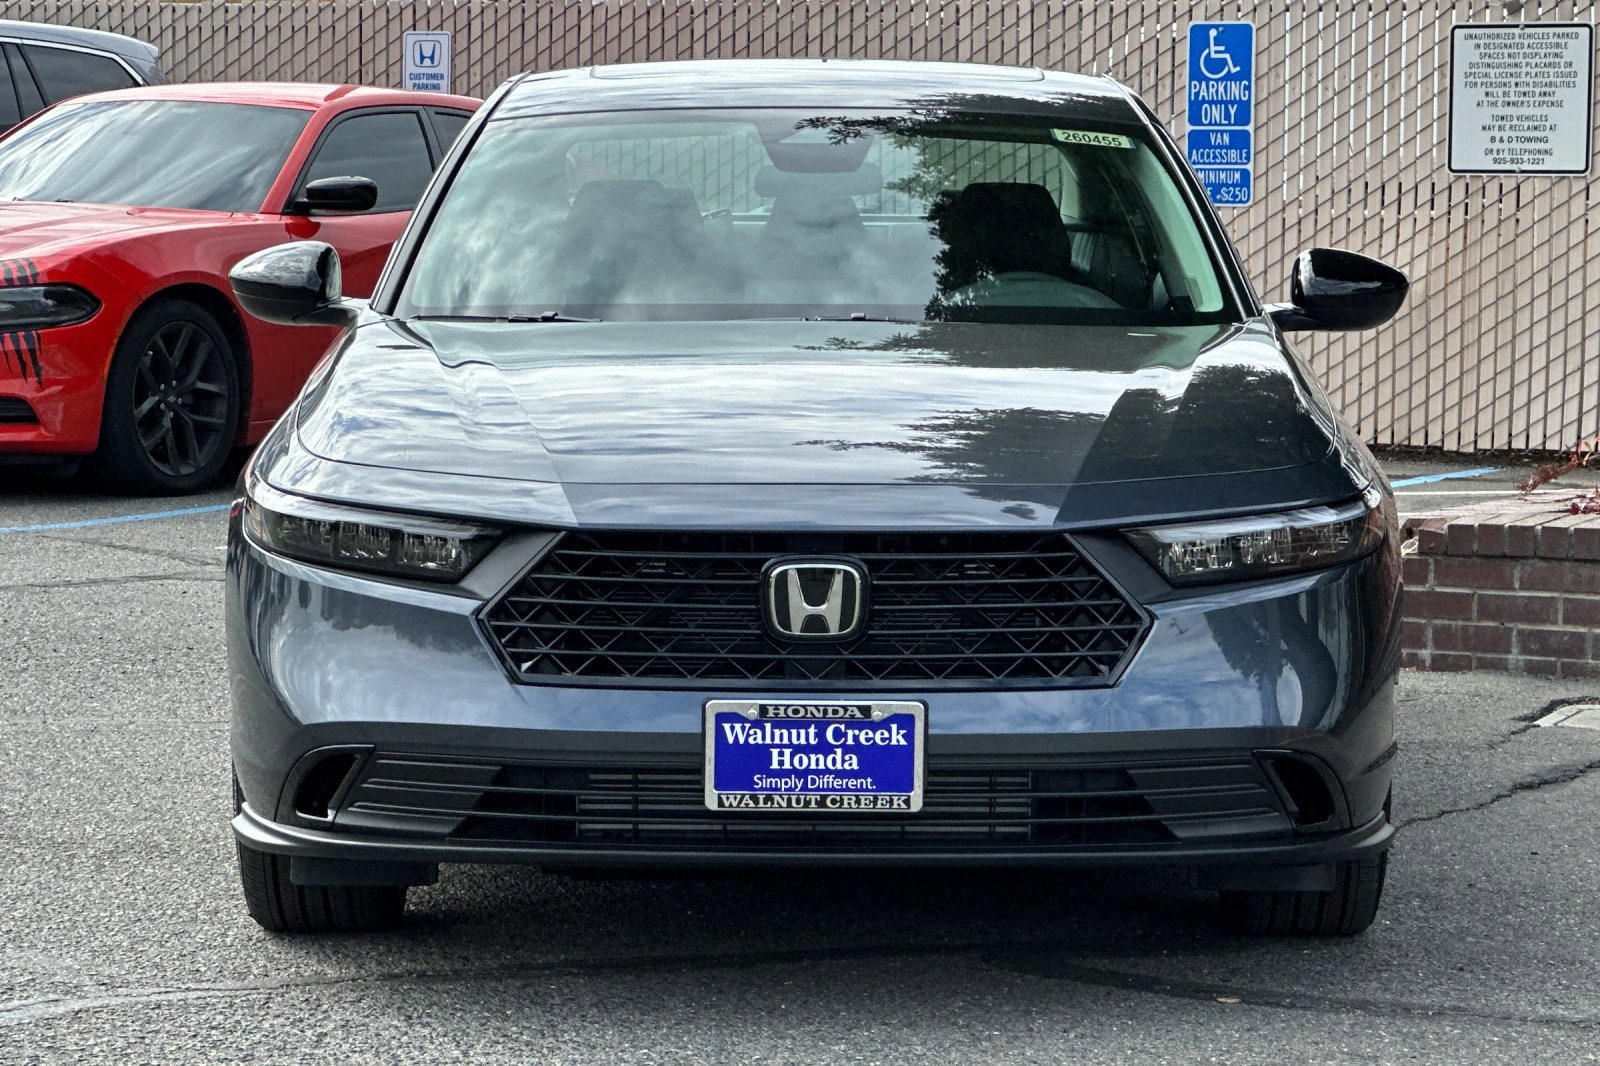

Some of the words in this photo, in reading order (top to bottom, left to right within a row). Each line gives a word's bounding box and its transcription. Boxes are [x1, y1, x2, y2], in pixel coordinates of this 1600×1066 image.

[409, 72, 444, 81] CUSTOMER
[1191, 81, 1249, 101] PARKING
[1202, 104, 1237, 124] ONLY
[1062, 132, 1122, 146] 260455
[1210, 132, 1229, 146] VAN
[1191, 149, 1248, 163] ACCESSIBLE
[1198, 170, 1240, 184] MINIMUM
[766, 706, 864, 718] HONDA
[722, 723, 818, 745] Walnut
[826, 723, 908, 745] Creek
[770, 748, 859, 770] Honda
[754, 775, 804, 791] Simply
[808, 775, 876, 789] Different.
[720, 795, 821, 808] WALNUT
[826, 795, 909, 808] CREEK
